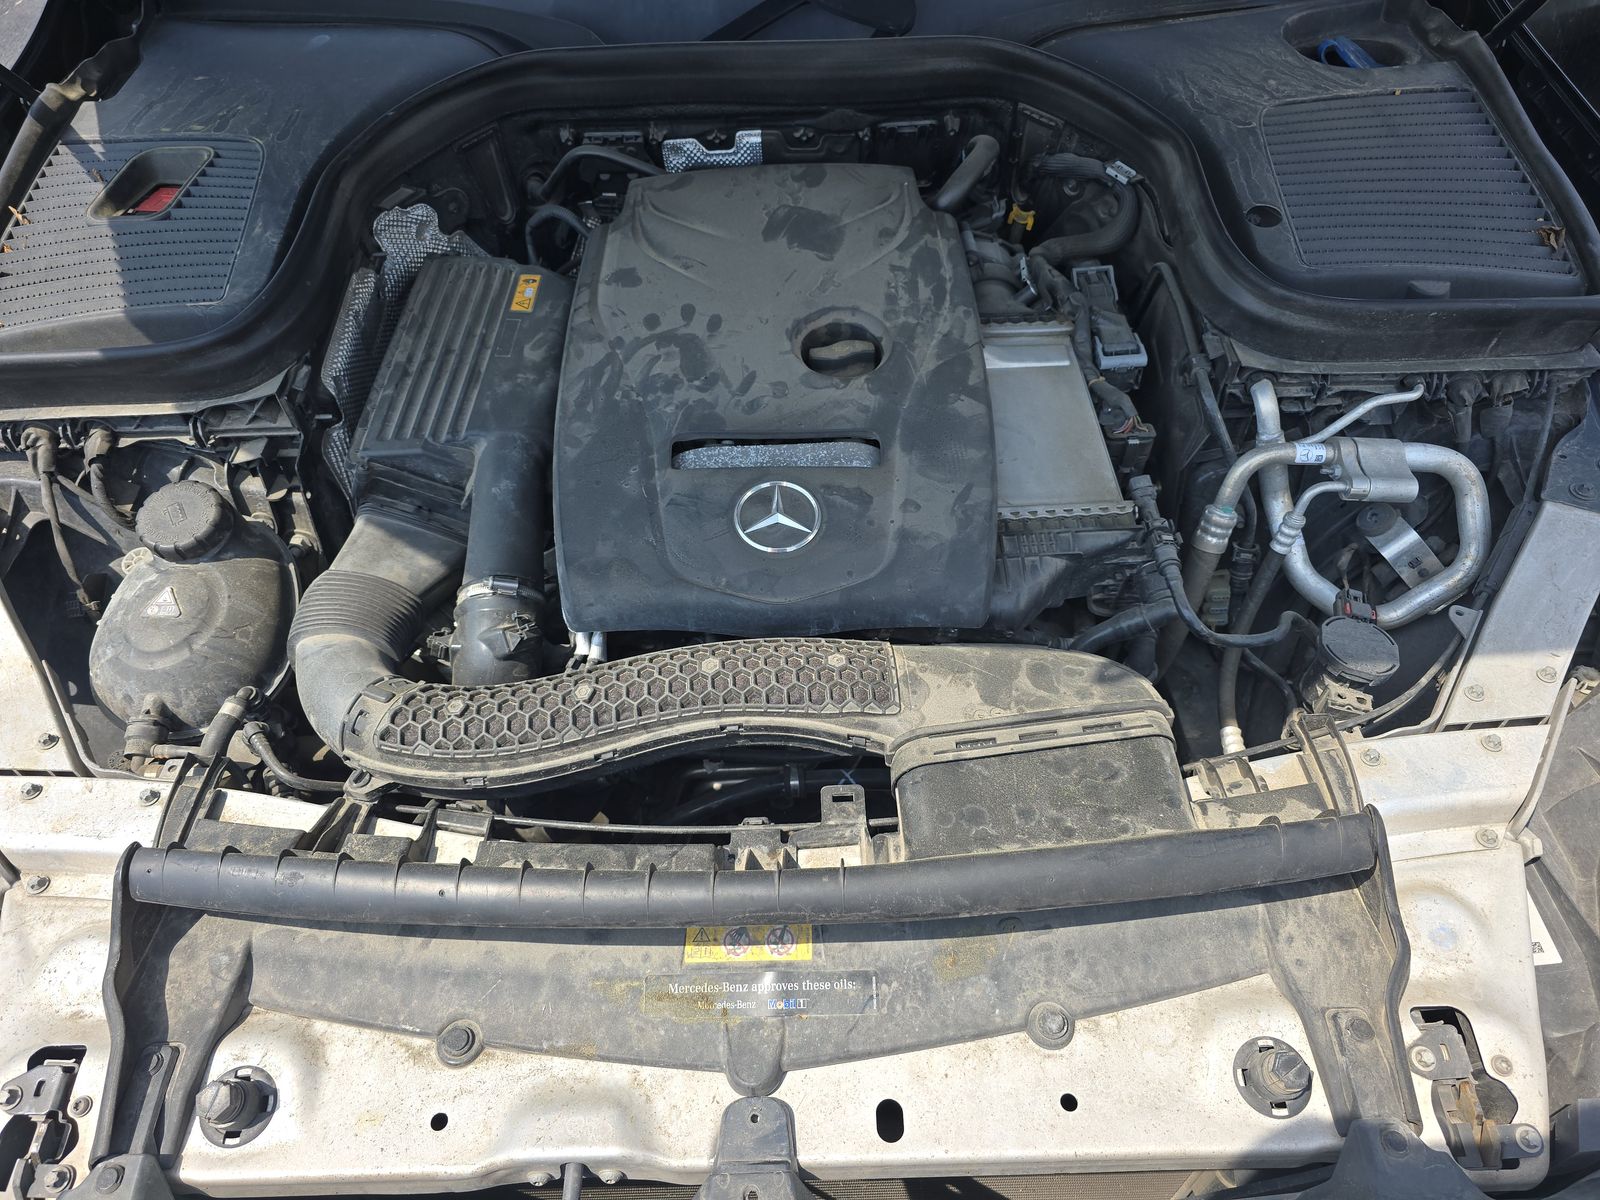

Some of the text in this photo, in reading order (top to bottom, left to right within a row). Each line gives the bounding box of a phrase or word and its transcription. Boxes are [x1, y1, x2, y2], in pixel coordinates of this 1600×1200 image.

[668, 978, 856, 995] Mercedes-Benz approves these oils:
[767, 999, 797, 1010] Mobil
